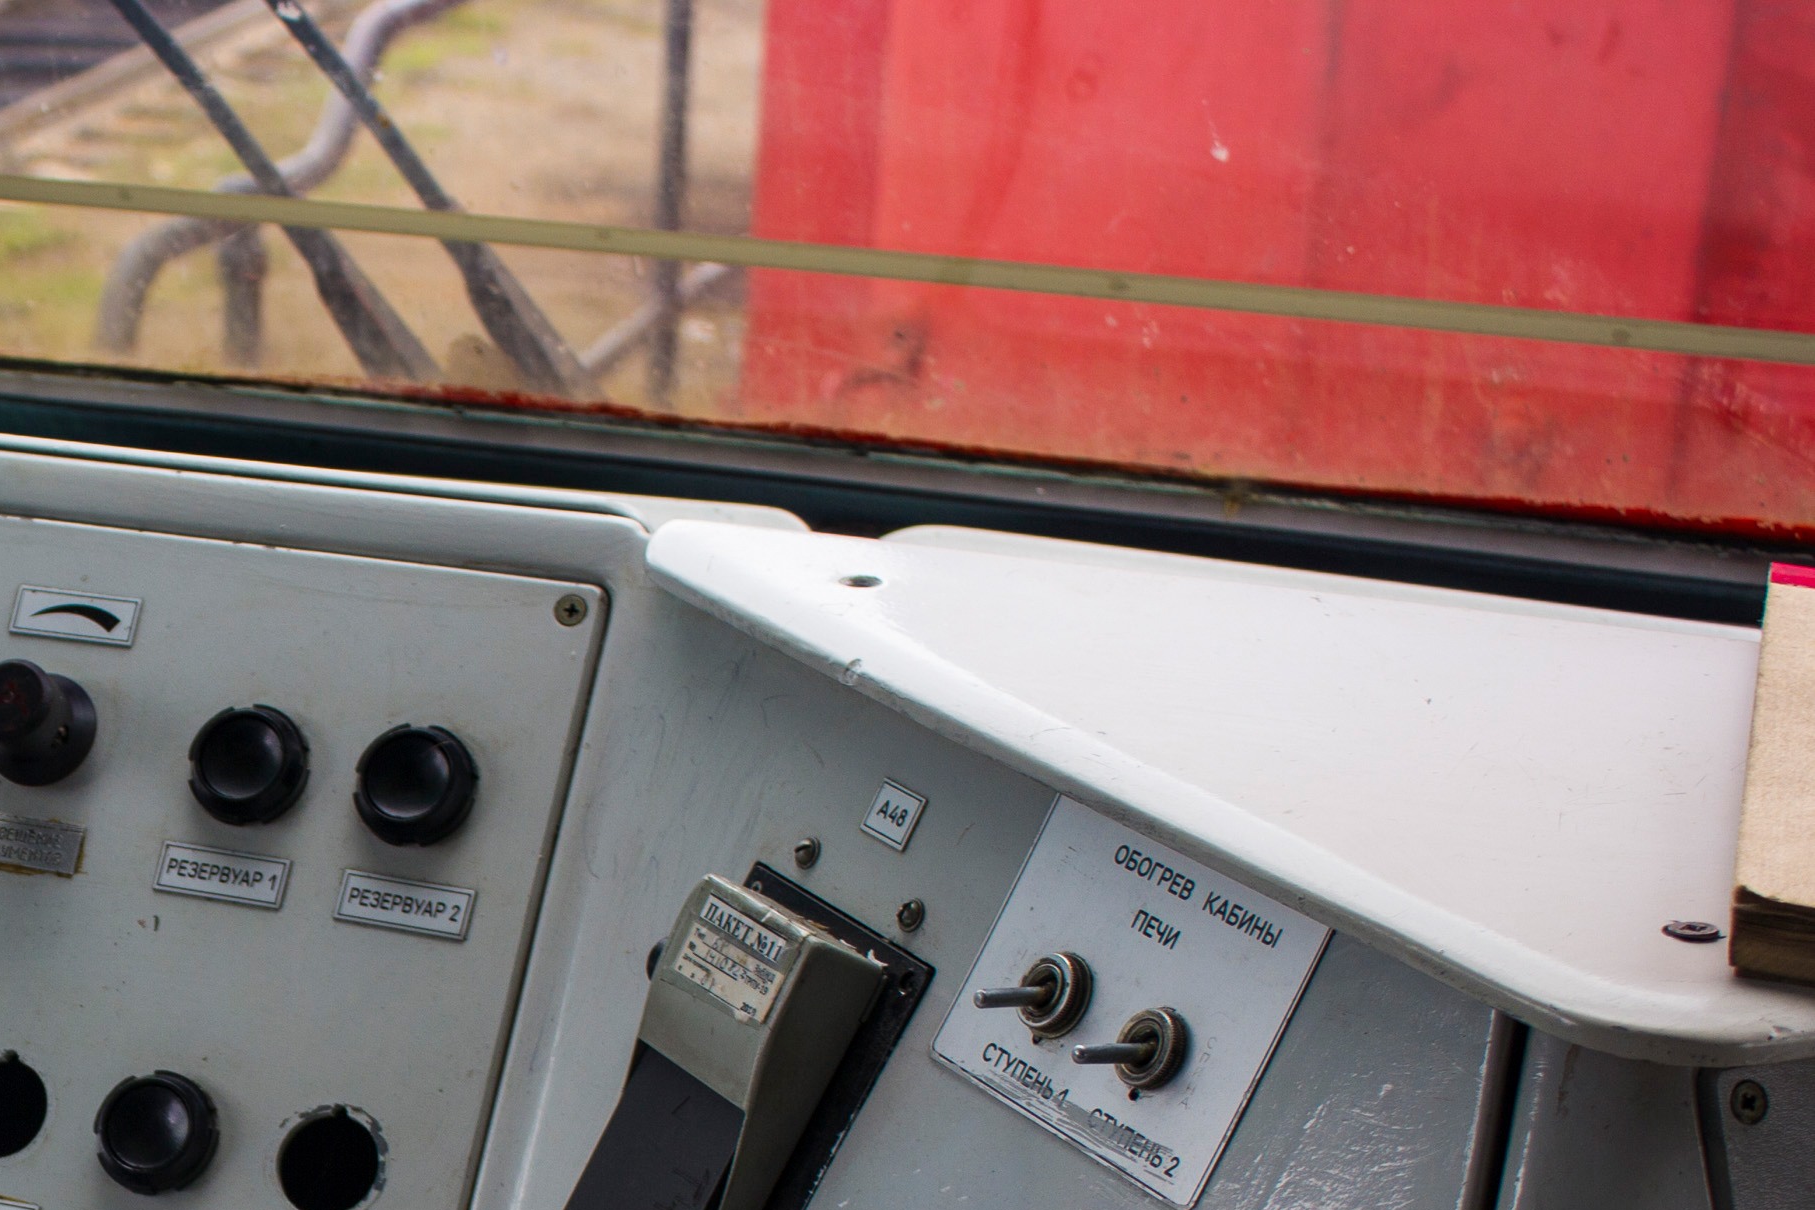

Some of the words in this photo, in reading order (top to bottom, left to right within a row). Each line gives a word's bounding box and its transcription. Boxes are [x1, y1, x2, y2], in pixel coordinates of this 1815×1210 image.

[165, 857, 263, 890] РЕЗЕРВУАР
[268, 873, 278, 891] 1
[347, 886, 447, 920] РЕЗЕРВУАР
[449, 904, 462, 923] 2
[1113, 844, 1196, 901] ОБОГРЕВ
[1201, 890, 1284, 950] КАБИНЫ
[702, 902, 755, 946] ПАКЕТ
[753, 931, 783, 963] №11
[1130, 908, 1182, 951] ПЕЧИ
[982, 1041, 1054, 1102] СТУПЕНЬ
[1087, 1107, 1164, 1169] СТУПЕНЬ
[1163, 1155, 1181, 1178] 2
